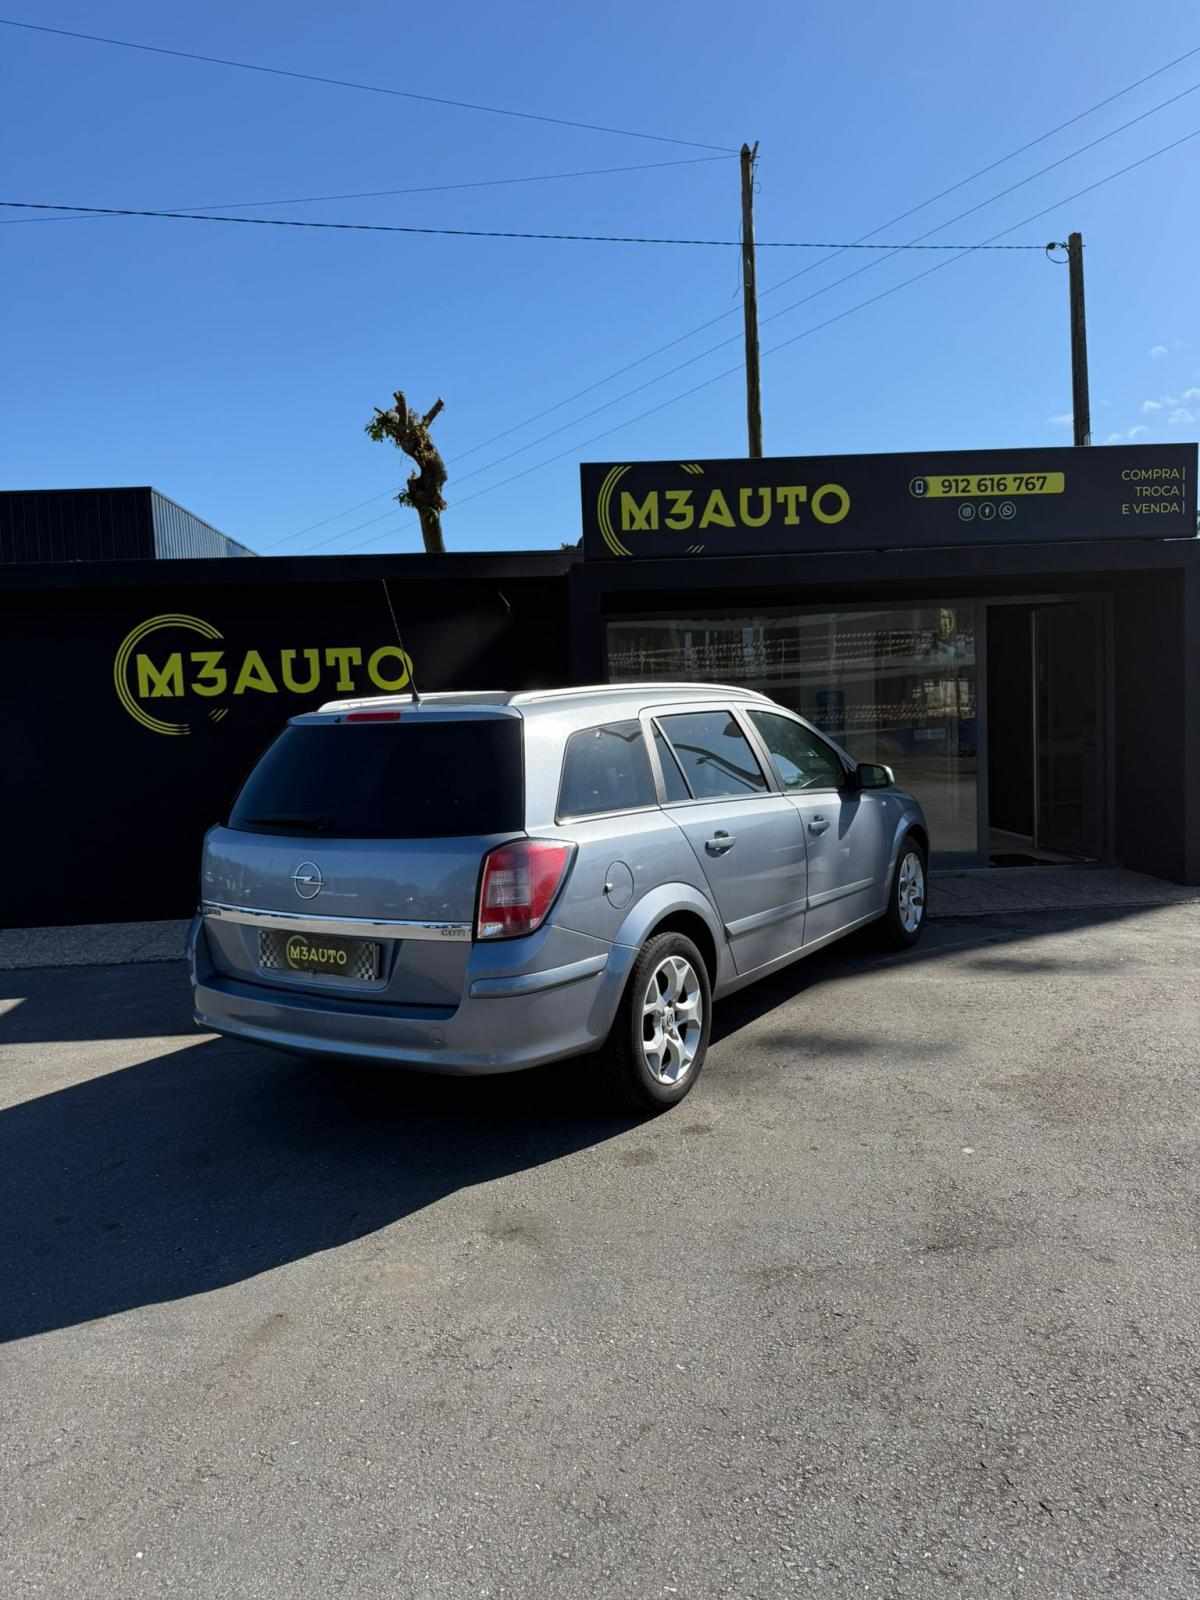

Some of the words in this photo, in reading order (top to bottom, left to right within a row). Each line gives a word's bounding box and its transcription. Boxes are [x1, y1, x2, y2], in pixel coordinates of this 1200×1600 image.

[1121, 467, 1180, 481] COMPRA
[941, 478, 971, 494] 912
[976, 477, 1008, 493] 616
[1012, 475, 1047, 492] 767
[1135, 485, 1180, 497] TROCA
[620, 483, 850, 531] M3AUTO
[1122, 503, 1130, 514] E
[1133, 502, 1180, 514] VENDA
[136, 646, 413, 698] M3AUTO
[290, 945, 347, 965] M3AUTO
